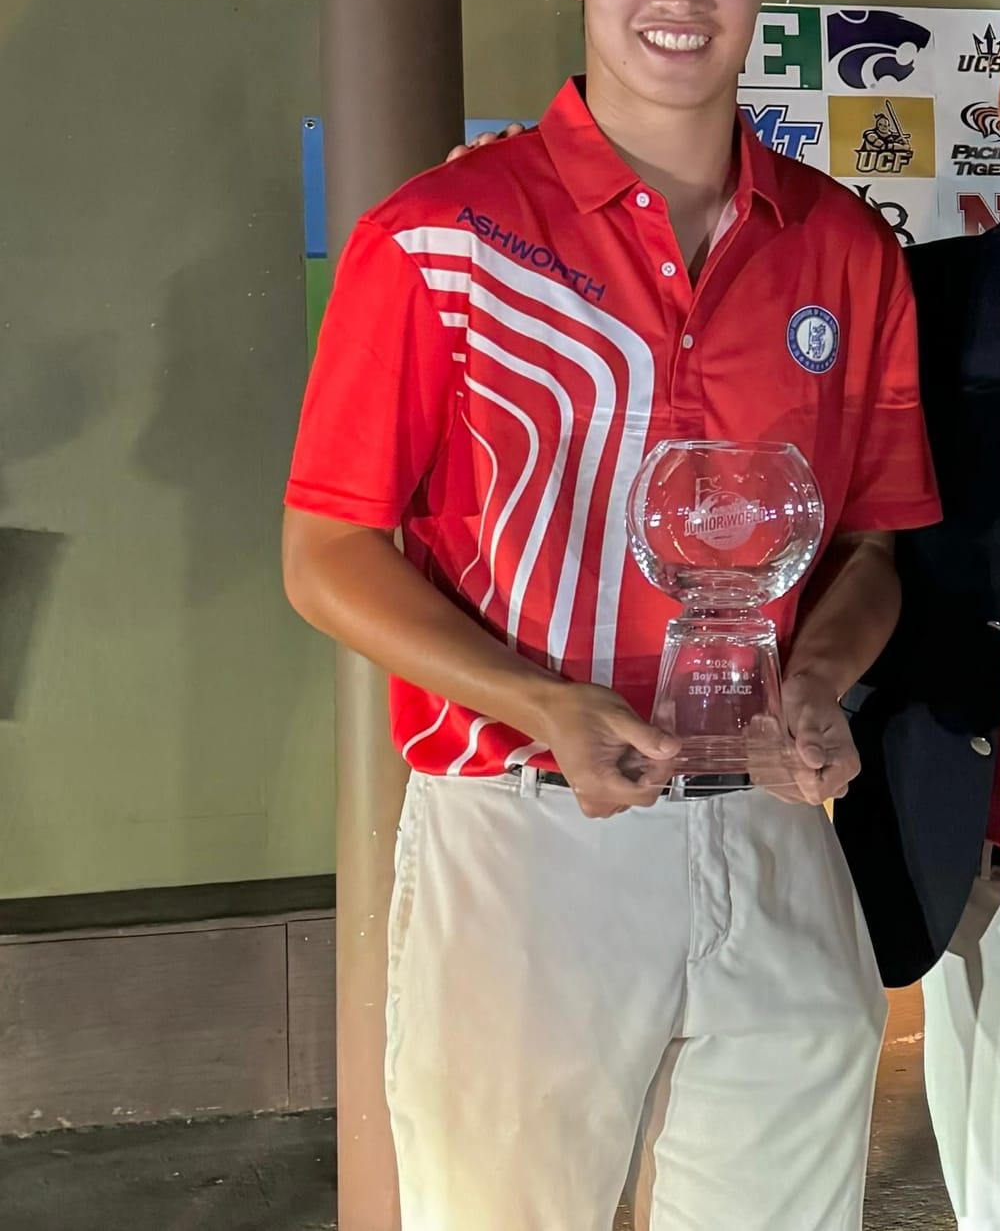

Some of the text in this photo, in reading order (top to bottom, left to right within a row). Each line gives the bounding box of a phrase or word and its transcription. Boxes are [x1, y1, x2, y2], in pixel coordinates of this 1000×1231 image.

[856, 150, 913, 173] UCF
[457, 206, 607, 302] ASHWORTH
[688, 685, 752, 695] 3RD PLACE
